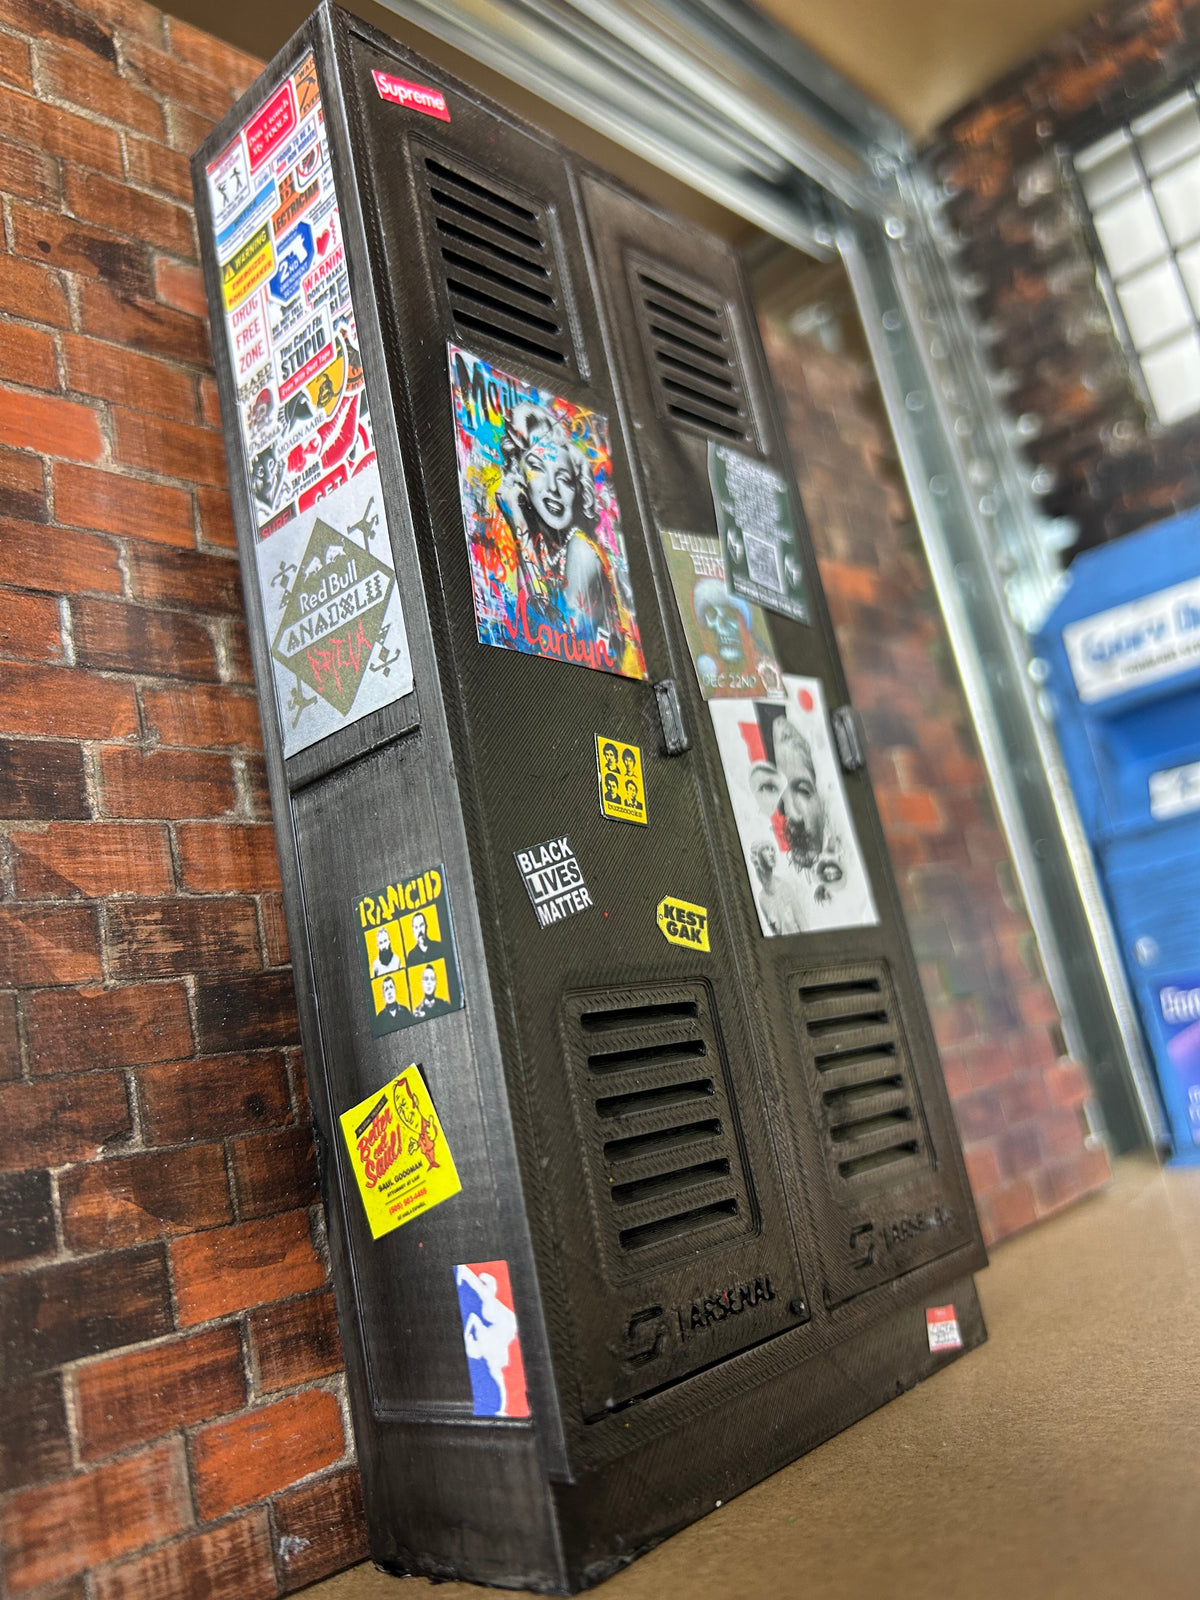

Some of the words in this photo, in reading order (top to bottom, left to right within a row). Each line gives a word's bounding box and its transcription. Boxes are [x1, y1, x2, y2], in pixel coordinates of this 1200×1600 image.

[378, 74, 445, 110] Supreme
[269, 100, 289, 125] touch
[252, 143, 263, 156] My
[265, 113, 288, 142] TOOLS
[273, 179, 319, 237] LECTRICIAN
[234, 230, 267, 270] WARNING
[278, 259, 299, 284] 2ND
[304, 251, 343, 292] WARNIN
[306, 279, 325, 302] DON'T
[325, 262, 343, 284] MAKE
[232, 294, 258, 328] DRUG
[236, 317, 261, 350] FREE
[280, 342, 293, 360] You
[239, 340, 264, 374] ZONE
[281, 327, 326, 380] STUPID
[238, 362, 272, 395] HARD
[299, 578, 327, 615] Red
[329, 558, 359, 593] Bull
[703, 673, 725, 689] DEC
[728, 672, 757, 689] 22ND
[607, 802, 643, 819] buzzcocks
[517, 837, 574, 874] BLACK
[527, 860, 582, 898] LIVES
[358, 870, 442, 928] RANCID
[536, 887, 593, 927] MATTER
[663, 903, 707, 930] KEST
[666, 921, 702, 944] GAK
[357, 1107, 393, 1163] Better
[365, 1123, 402, 1188] Saul!
[378, 1180, 394, 1192] SAUL
[394, 1160, 423, 1183] GOODMAN
[690, 1274, 776, 1330] ARSENAL
